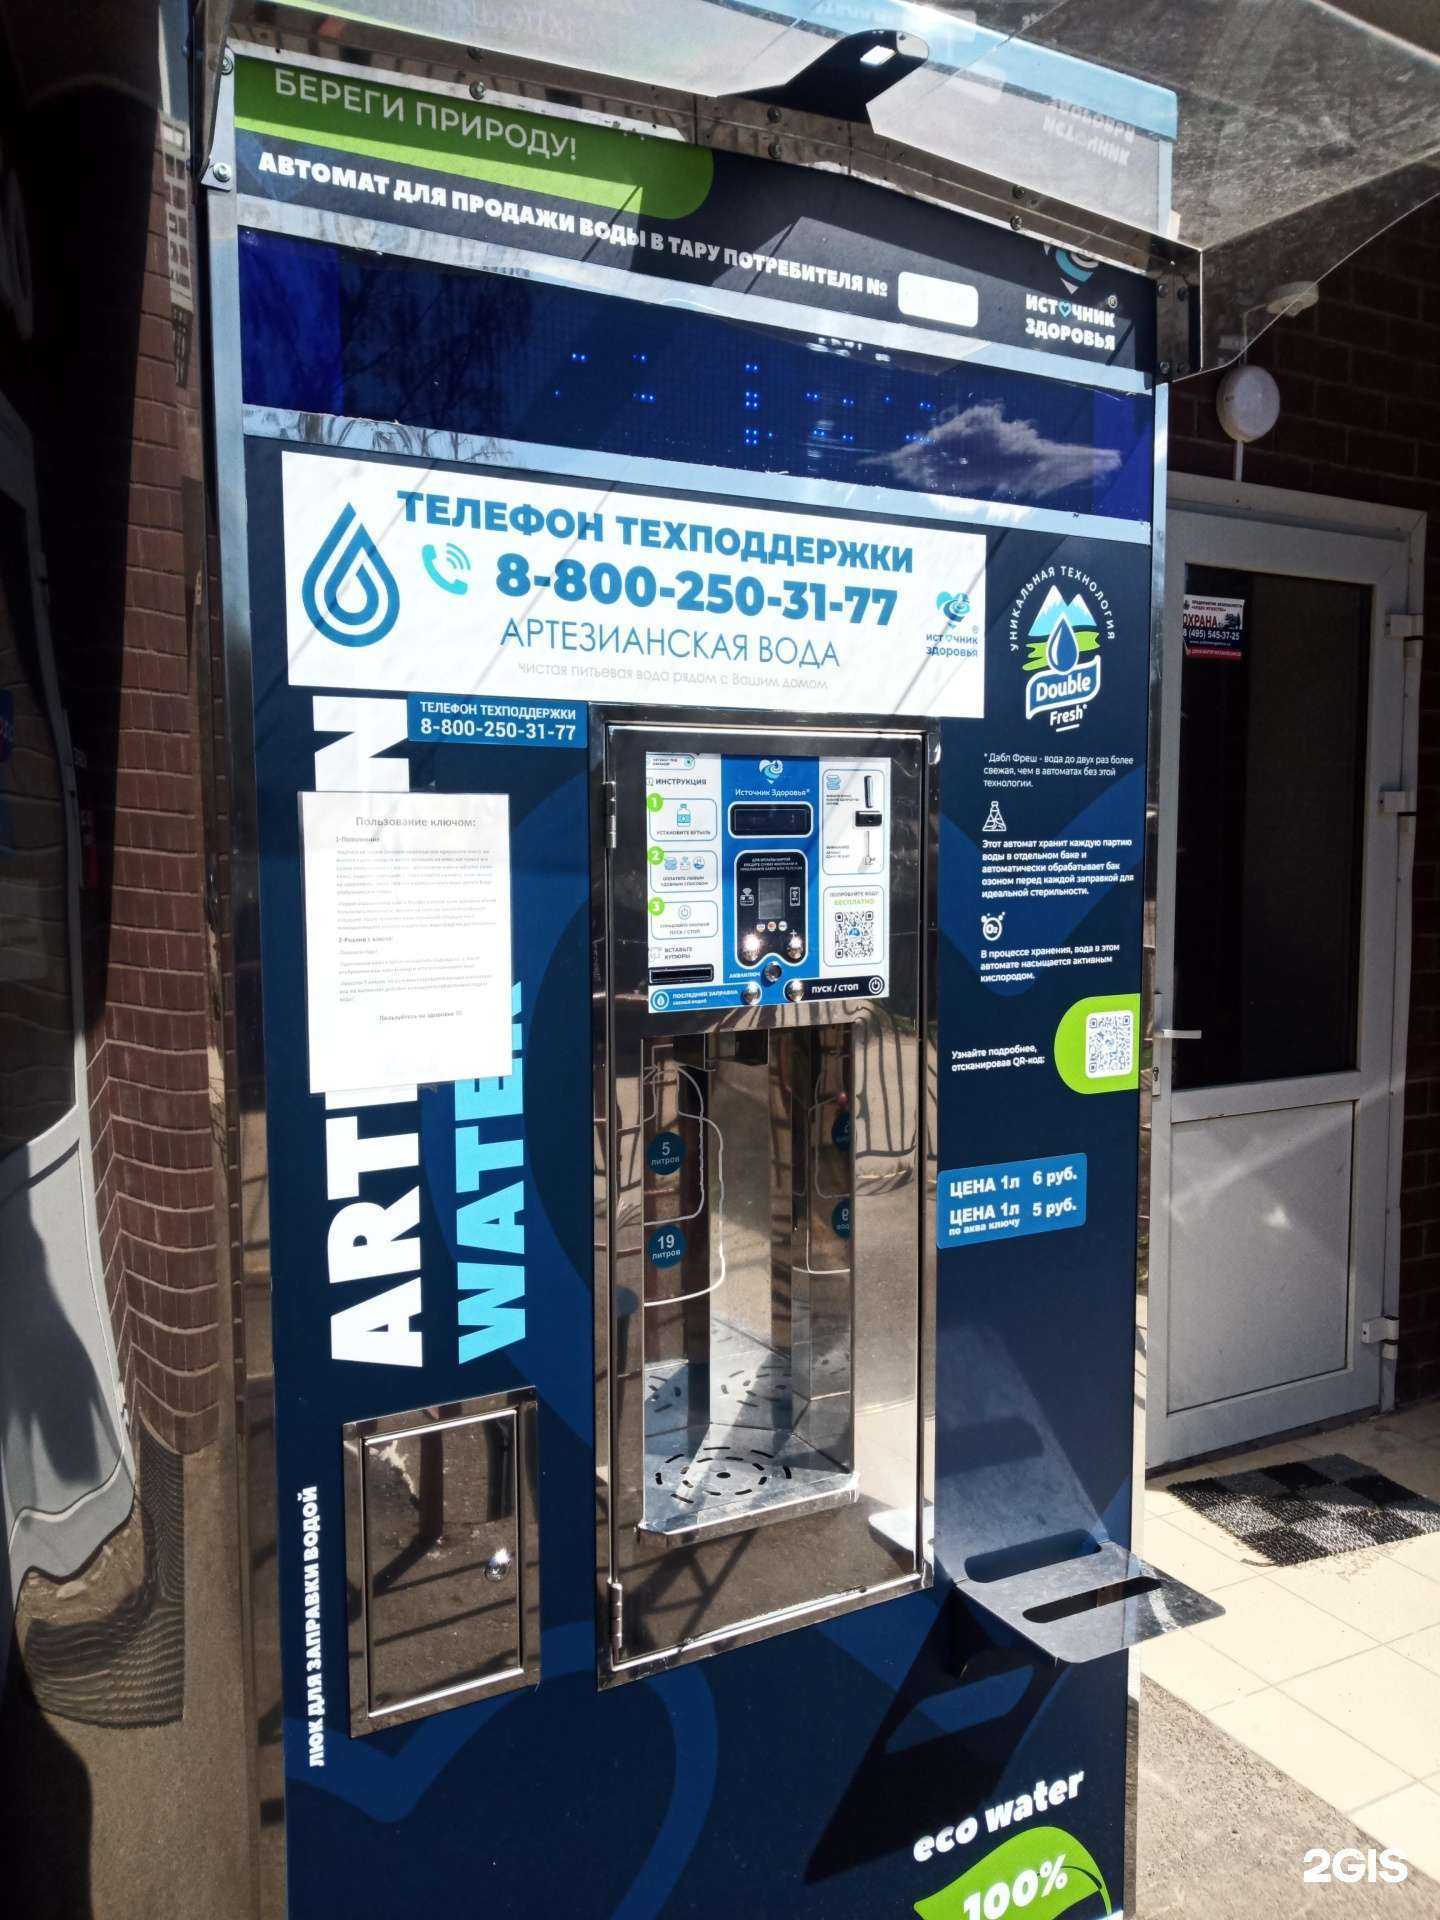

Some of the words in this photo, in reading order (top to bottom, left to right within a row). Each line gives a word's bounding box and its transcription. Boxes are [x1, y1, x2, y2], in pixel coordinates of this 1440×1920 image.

[274, 68, 405, 122] БЕРЕГИ
[416, 102, 577, 161] ПРИРОДУ!
[258, 151, 390, 194] АВТОМАТ
[393, 178, 447, 208] ДЛЯ
[451, 191, 576, 234] ПРОДАЖИ
[580, 217, 646, 248] ВОДЫ
[651, 235, 664, 251] В
[667, 237, 720, 268] ТАРУ
[723, 247, 864, 292] ПОТРЕБИТЕЛЯ
[866, 277, 889, 298] №
[1025, 317, 1116, 351] ЗДОРОВЬЯ
[396, 490, 604, 542] ТЕЛЕФОН
[616, 515, 913, 573] ТЕХПОДДЕРЖКИ
[496, 552, 898, 626] 8-800-250-31-77
[1010, 566, 1056, 652] УНИКАЛЬНАЯ
[1060, 565, 1116, 640] ТЕХНОЛОГИЯ
[1183, 614, 1217, 628] ОХРАНА
[500, 617, 748, 662] АРТЕЗИАНСКАЯ
[759, 635, 840, 669] ВОДА
[571, 665, 632, 680] питьевая
[636, 670, 669, 682] вода
[673, 672, 718, 685] рядом
[782, 677, 828, 689] домом
[1036, 674, 1092, 702] Double
[420, 701, 477, 716] ТЕЛЕФОН
[480, 704, 577, 720] ТЕХПОДДЕРЖКИ
[420, 718, 576, 741] 8-800-250-31-77
[989, 753, 1011, 763] Дабл
[1012, 753, 1037, 763] Фреш
[1044, 755, 1063, 764] вода
[1064, 756, 1075, 765] до
[1076, 756, 1094, 765] двух
[1095, 757, 1109, 765] раз
[1110, 755, 1134, 765] более
[983, 767, 1016, 776] свежая,
[1042, 768, 1082, 776] автоматах
[1083, 767, 1098, 775] без
[1098, 767, 1116, 776] этой
[656, 778, 707, 786] ИНСТРУКЦИЯ
[355, 816, 428, 828] Пользование
[982, 840, 1001, 848] Этот
[1003, 840, 1037, 848] автомат
[1038, 839, 1068, 849] хранит
[1069, 839, 1101, 848] каждую
[1103, 838, 1132, 848] партию
[982, 853, 1005, 861] воды
[1013, 852, 1059, 861] отдельном
[1060, 850, 1080, 859] баке
[982, 864, 1046, 873] автоматически
[1048, 862, 1104, 873] обрабатывает
[1105, 861, 1120, 870] бак
[982, 877, 1014, 886] озоном
[1015, 877, 1042, 886] перед
[1043, 874, 1075, 884] каждой
[1077, 873, 1118, 884] заправкой
[1119, 874, 1134, 882] для
[982, 888, 1028, 899] идеальной
[1030, 887, 1089, 897] стерильности.
[981, 950, 987, 958] В
[989, 949, 1029, 959] процессе
[1031, 946, 1073, 957] хранения,
[1074, 946, 1093, 955] вода
[1101, 944, 1120, 952] этом
[980, 962, 1020, 971] автомате
[1021, 958, 1071, 968] насыщается
[1073, 955, 1113, 964] активным
[980, 972, 1035, 983] кислородом.
[812, 985, 832, 994] ПУСК
[838, 984, 859, 992] СТОП
[951, 1048, 987, 1060] Узнайте
[988, 1044, 1037, 1057] подробнее,
[951, 1058, 1011, 1072] отсканировав
[661, 1142, 671, 1155] 5
[651, 1156, 680, 1166] литров
[455, 981, 526, 1366] WATE
[950, 1177, 996, 1199] ЦЕНА
[1001, 1175, 1020, 1190] 1л
[1032, 1170, 1042, 1186] 6
[1047, 1165, 1078, 1187] руб.
[950, 1204, 995, 1226] ЦЕНА
[1000, 1202, 1020, 1217] 1л
[1032, 1202, 1042, 1217] 5
[1046, 1197, 1077, 1218] руб.
[949, 1227, 960, 1236] по
[963, 1225, 986, 1233] аква
[988, 1218, 1020, 1230] ключу
[657, 1234, 675, 1250] 19
[652, 1249, 681, 1261] литров
[297, 1486, 320, 1561] ВОДОЙ
[304, 1563, 321, 1672] ЗАПРАВКИ
[307, 1673, 326, 1716] ДЛЯ
[309, 1716, 325, 1768] ЛЮК
[913, 1814, 979, 1863] eco
[984, 1769, 1085, 1834] water
[962, 1853, 1067, 1920] 100%
